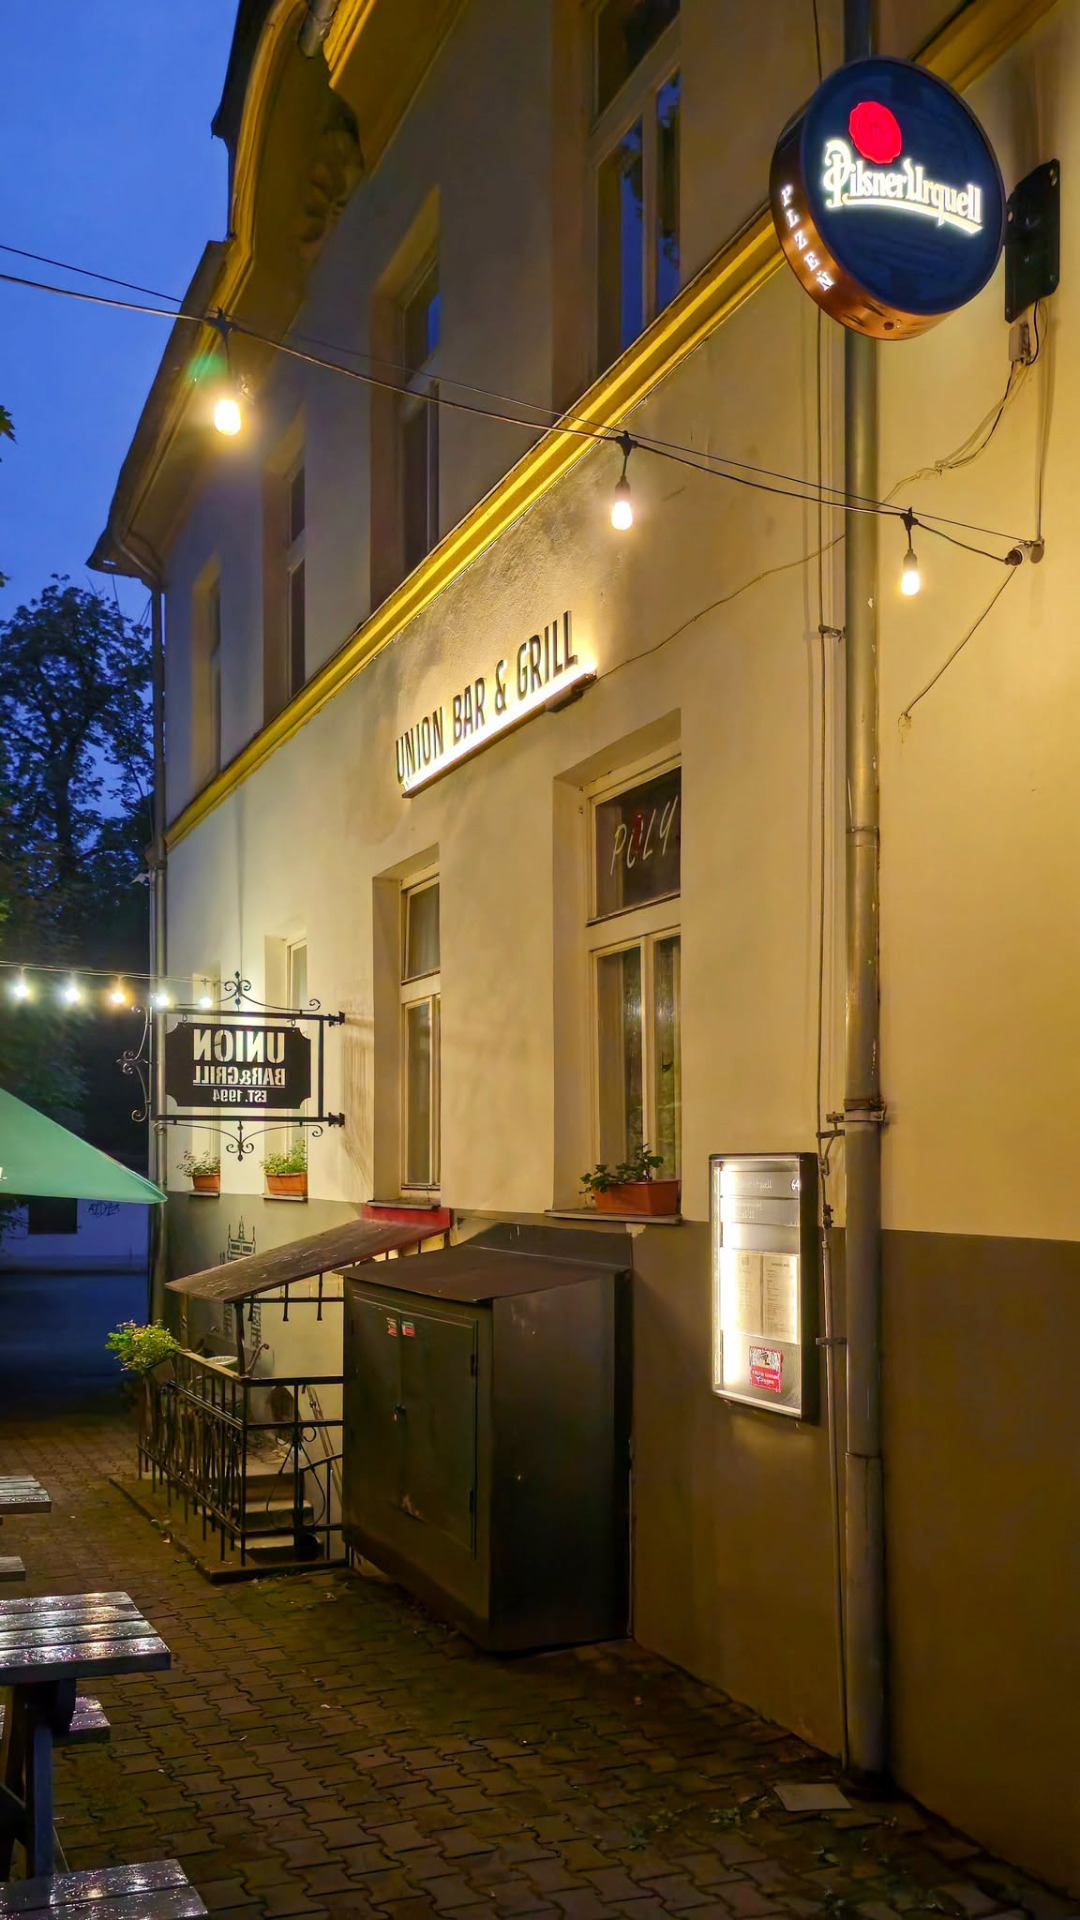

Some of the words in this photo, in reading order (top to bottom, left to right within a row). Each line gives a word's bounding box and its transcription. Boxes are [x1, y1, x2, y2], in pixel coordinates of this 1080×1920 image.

[823, 139, 907, 209] Pilsner
[903, 158, 982, 227] Urquell
[395, 706, 445, 784] UNION
[452, 677, 486, 746] BAR
[494, 660, 508, 715] &
[516, 610, 578, 701] GRILL
